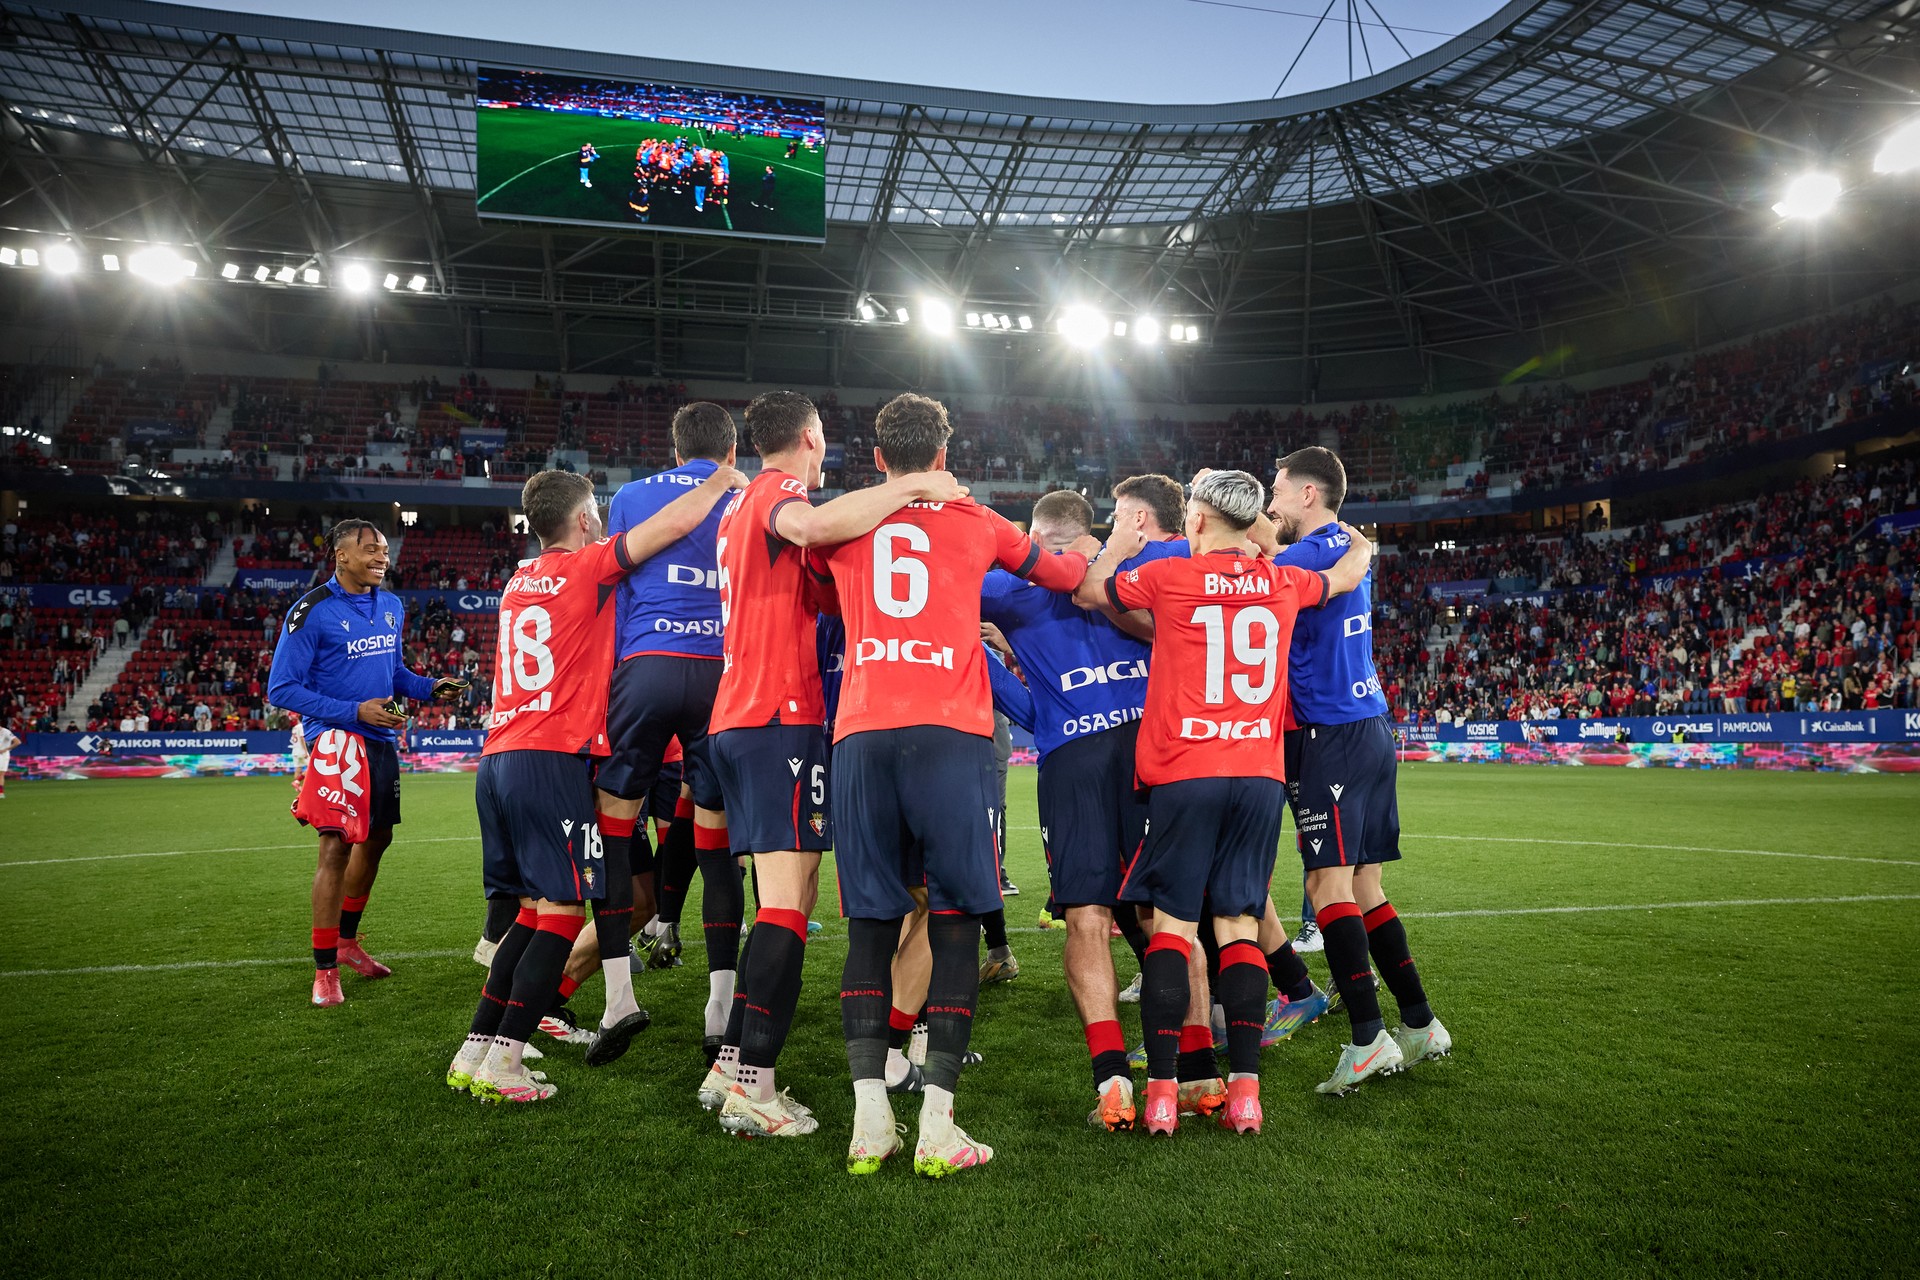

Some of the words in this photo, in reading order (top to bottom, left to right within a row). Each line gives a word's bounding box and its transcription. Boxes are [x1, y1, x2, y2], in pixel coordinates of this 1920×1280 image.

[873, 522, 930, 619] 6
[655, 618, 725, 637] OSASU
[500, 605, 555, 696] 18
[856, 637, 954, 670] DIGI
[1190, 604, 1280, 705] 19
[1060, 659, 1149, 692] DIGI
[110, 738, 161, 748] BAIKOR
[433, 736, 474, 746] CaixaBank
[1180, 717, 1272, 741] DIGI
[1723, 721, 1773, 733] PAMPLONA
[1823, 721, 1865, 732] CaixaBank
[811, 764, 825, 805] 5
[580, 822, 604, 860] 18
